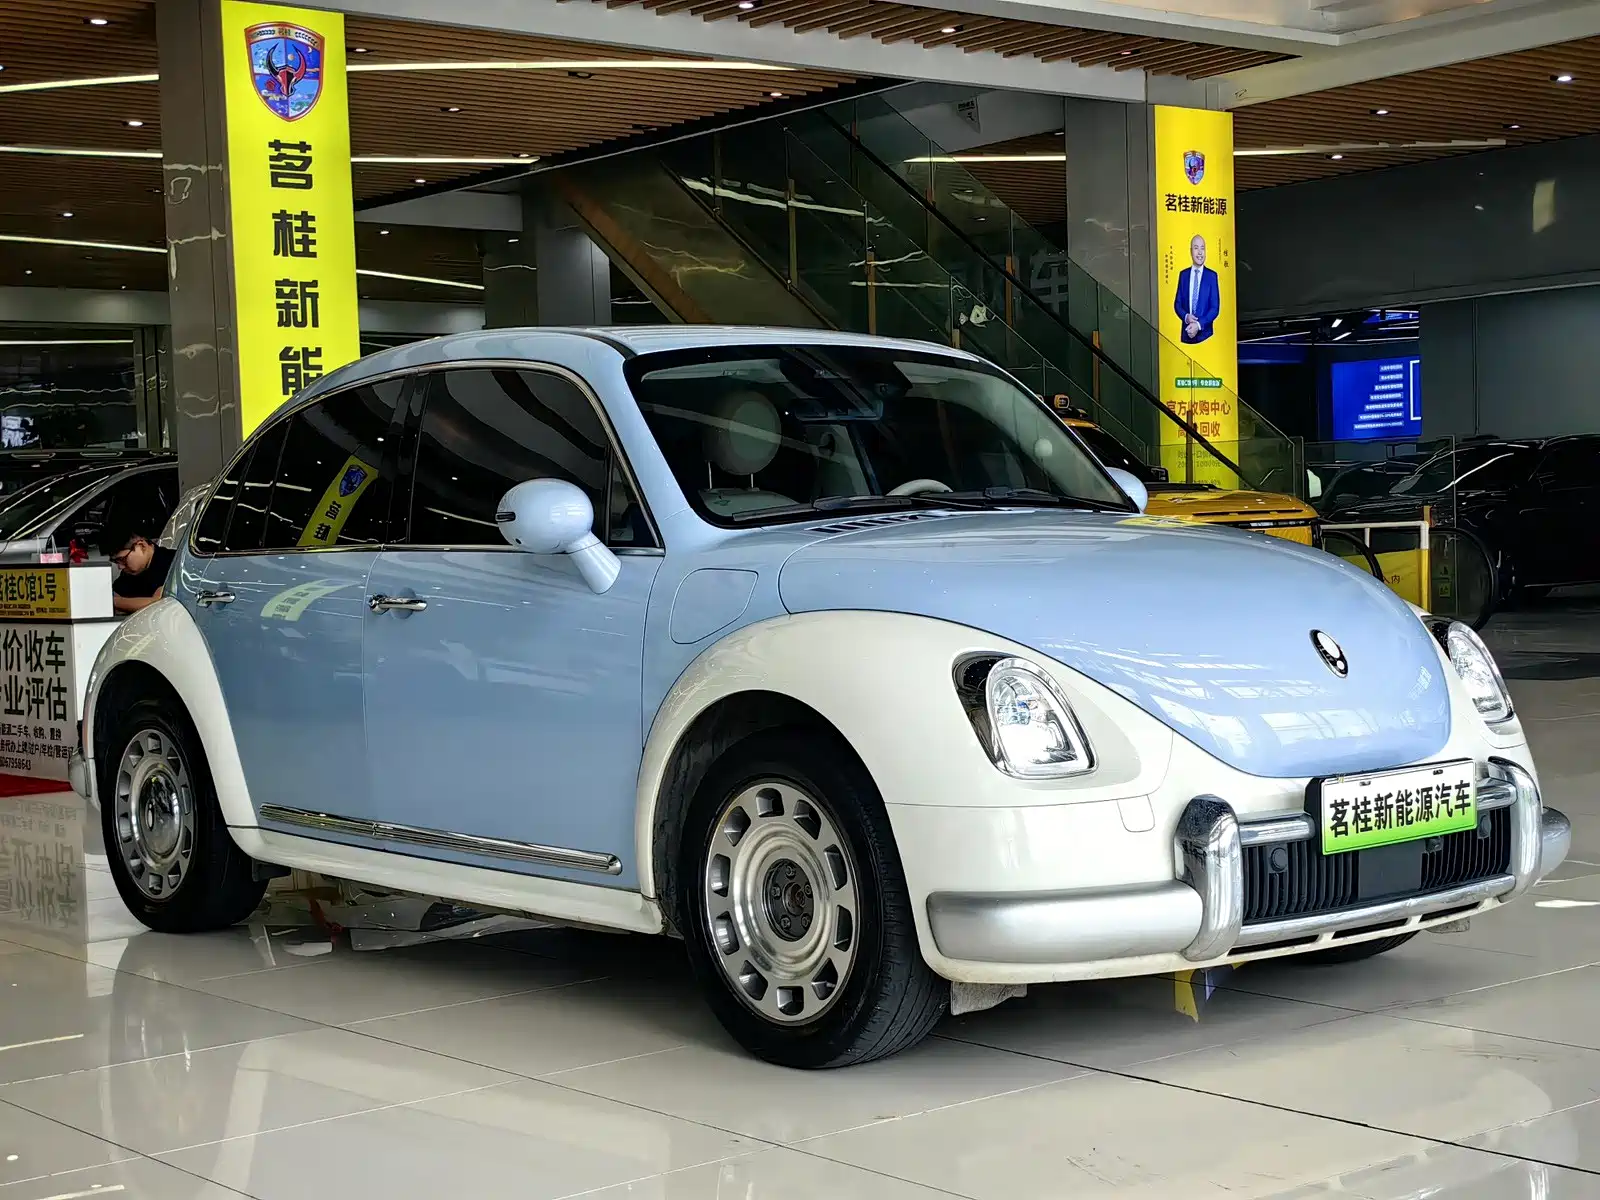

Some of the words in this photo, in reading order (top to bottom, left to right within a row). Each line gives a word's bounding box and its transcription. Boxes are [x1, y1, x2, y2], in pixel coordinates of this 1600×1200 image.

[1165, 194, 1227, 215] 茗桂新能源
[0, 572, 57, 602] 桂C馆1号
[0, 629, 66, 674] 价收车
[0, 675, 67, 721] 业评估
[1329, 780, 1471, 838] 茗桂新能源汽车
